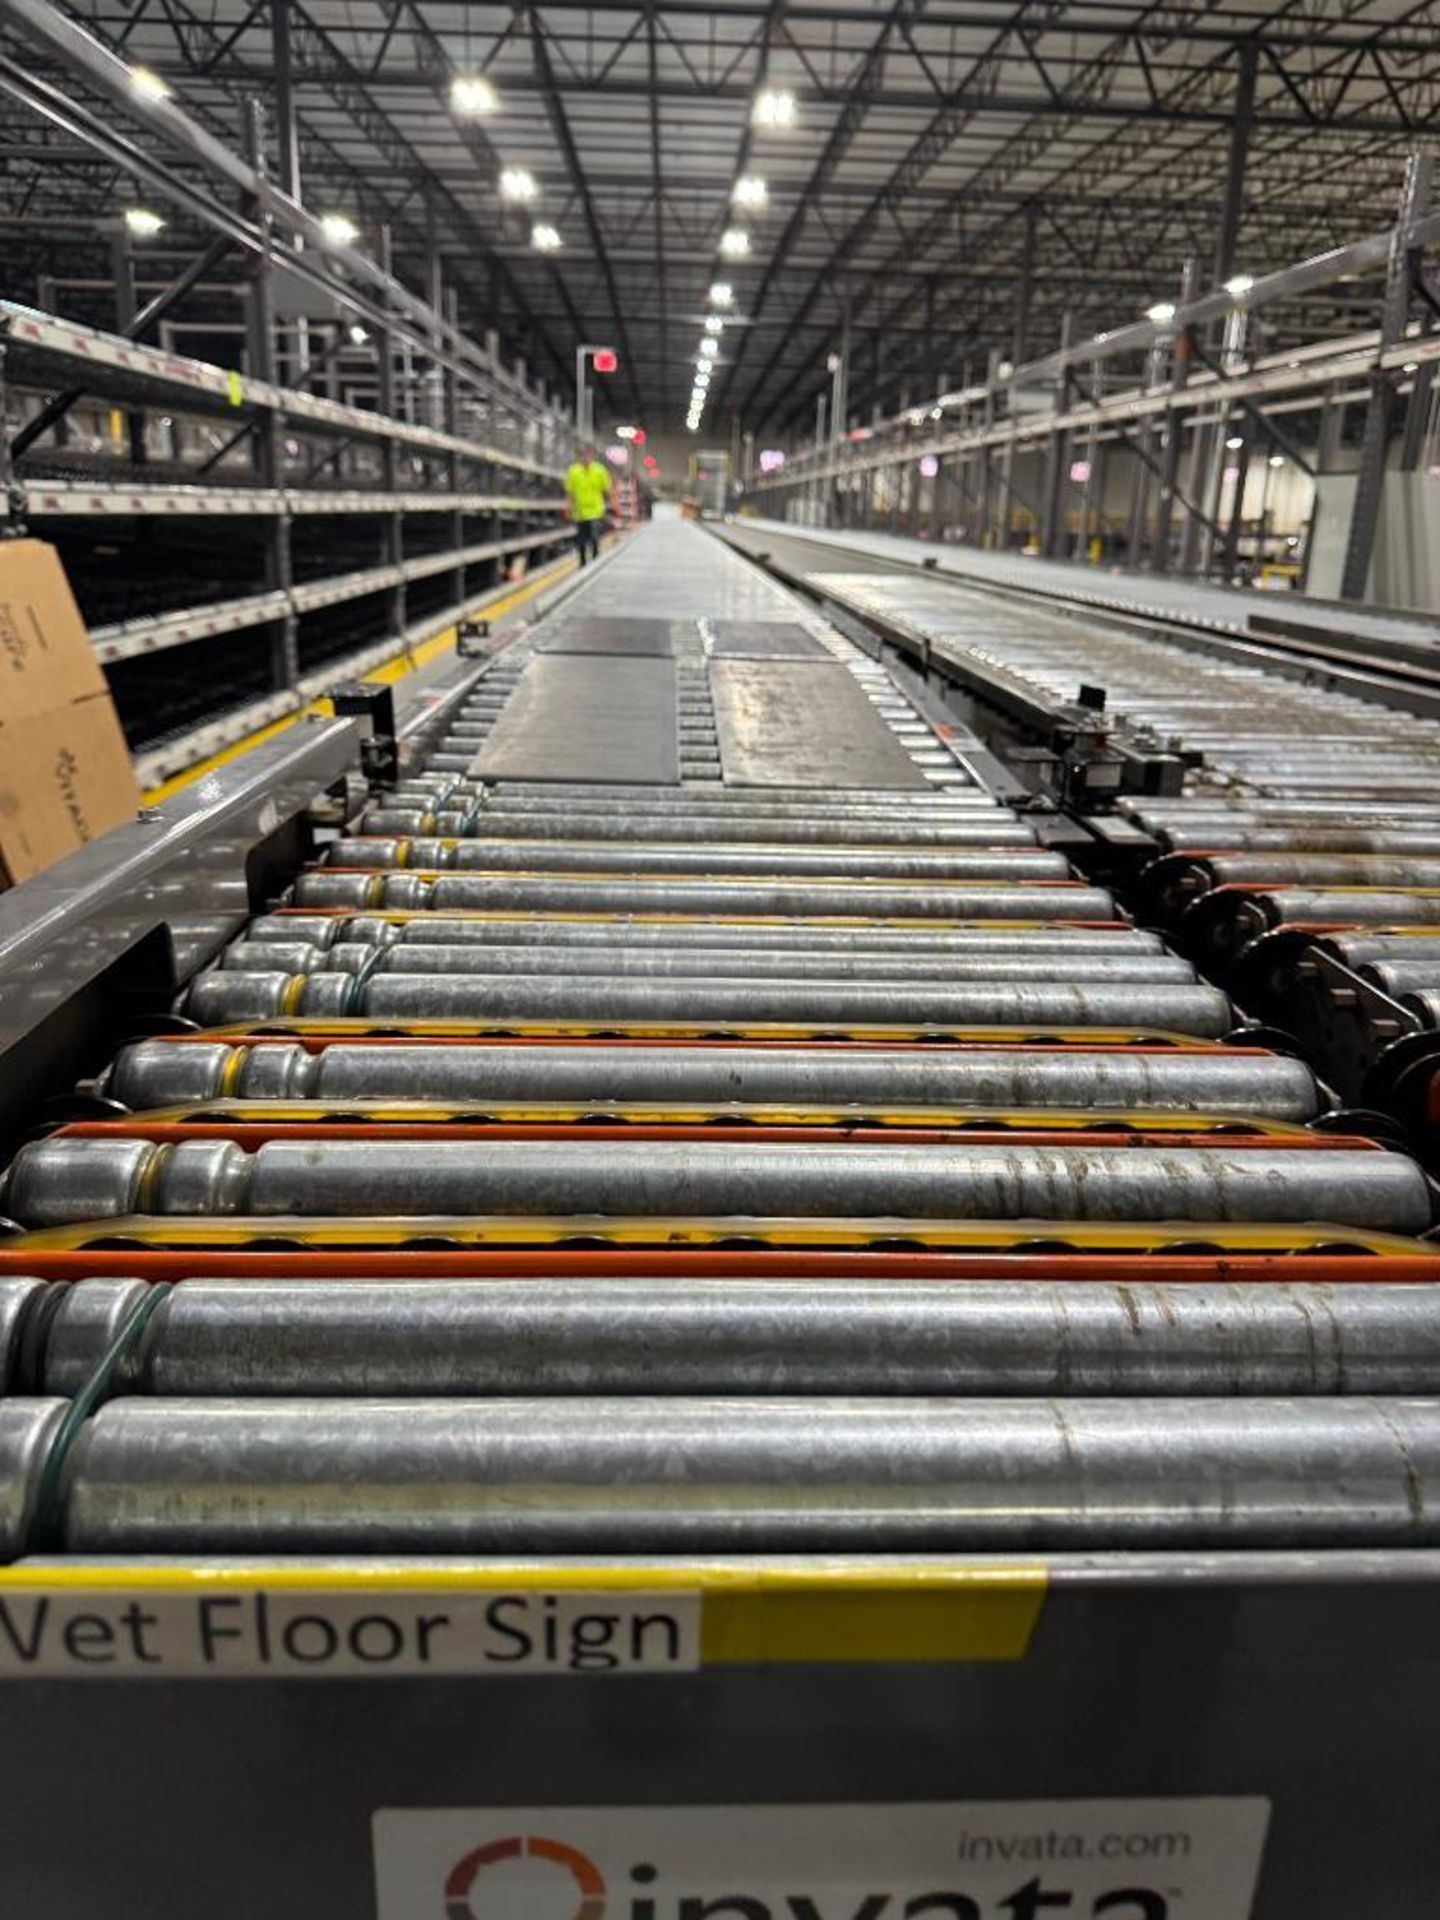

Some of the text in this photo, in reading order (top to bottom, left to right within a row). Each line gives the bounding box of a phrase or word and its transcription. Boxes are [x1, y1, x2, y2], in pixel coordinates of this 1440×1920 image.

[197, 1592, 450, 1663] Floor
[484, 1595, 680, 1672] Sign
[958, 1828, 1192, 1860] invata.com
